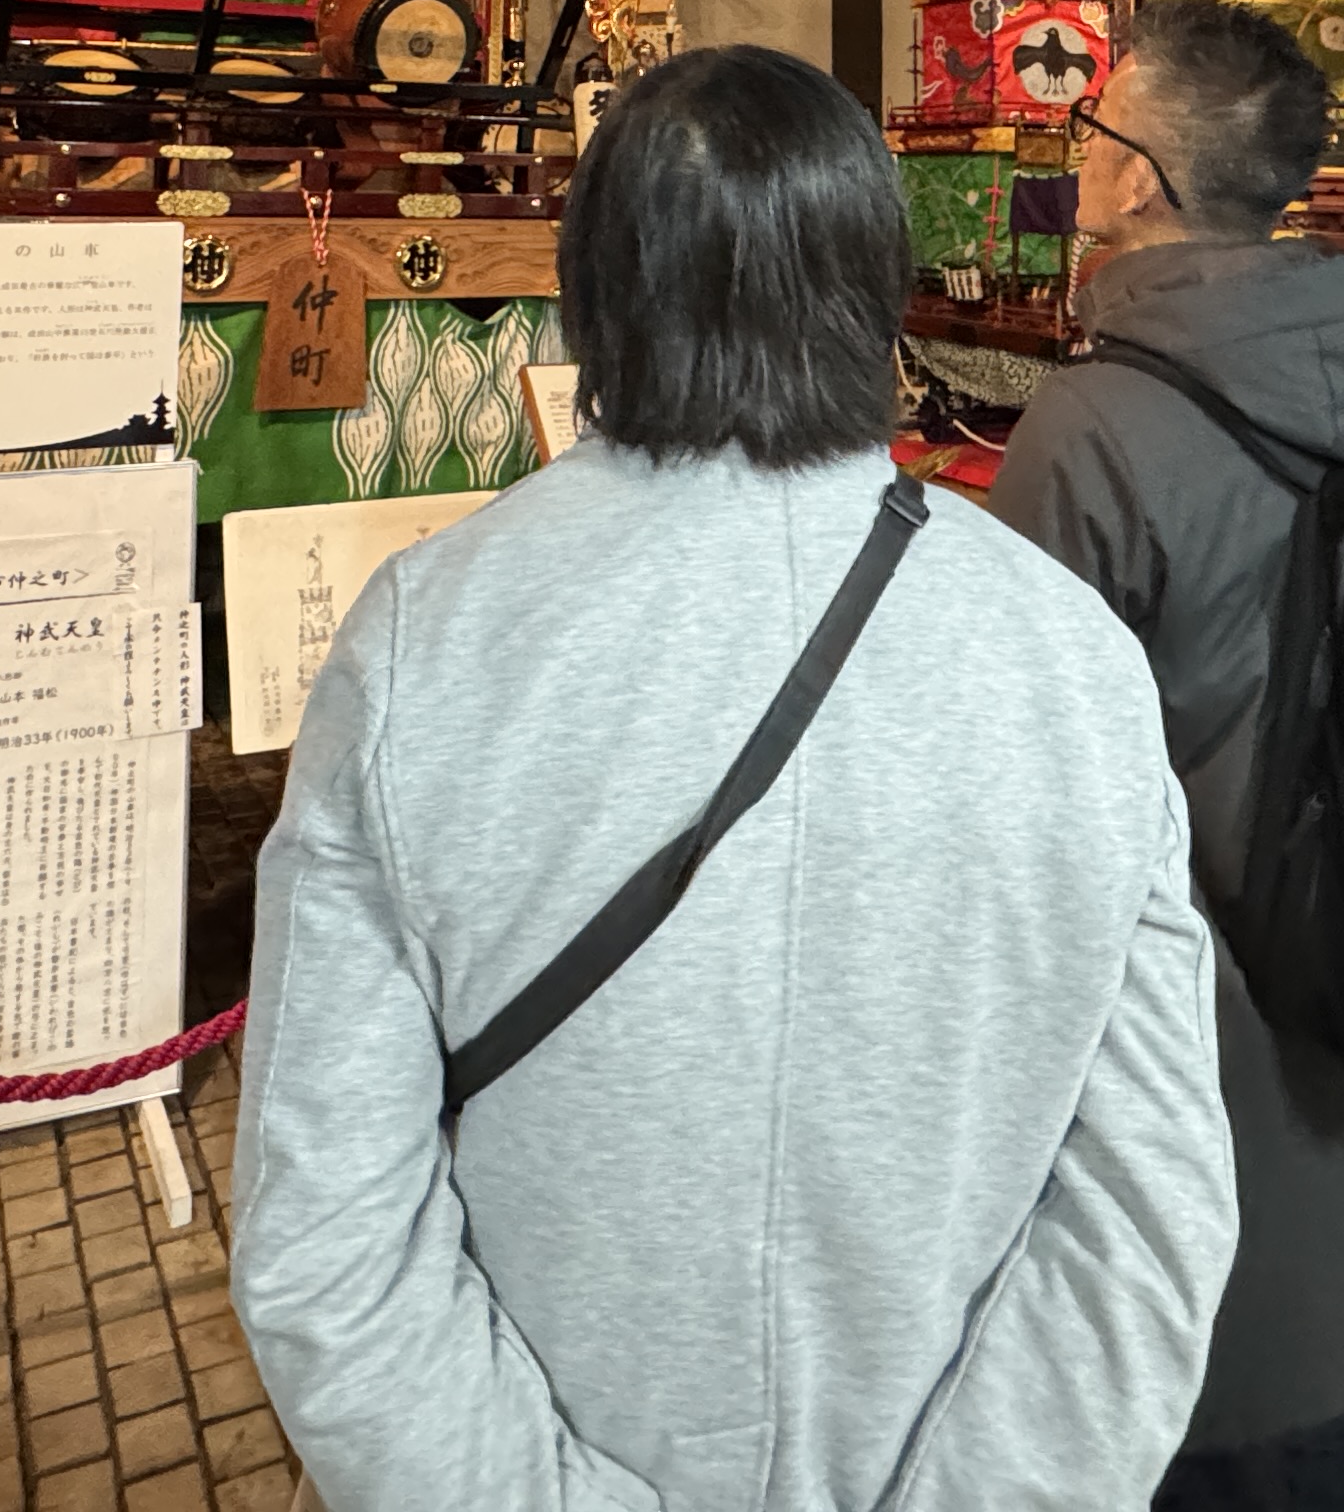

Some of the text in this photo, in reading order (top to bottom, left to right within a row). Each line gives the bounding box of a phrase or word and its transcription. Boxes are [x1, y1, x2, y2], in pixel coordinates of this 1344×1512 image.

[292, 274, 338, 386] 仲町
[14, 616, 105, 644] 神武天皇
